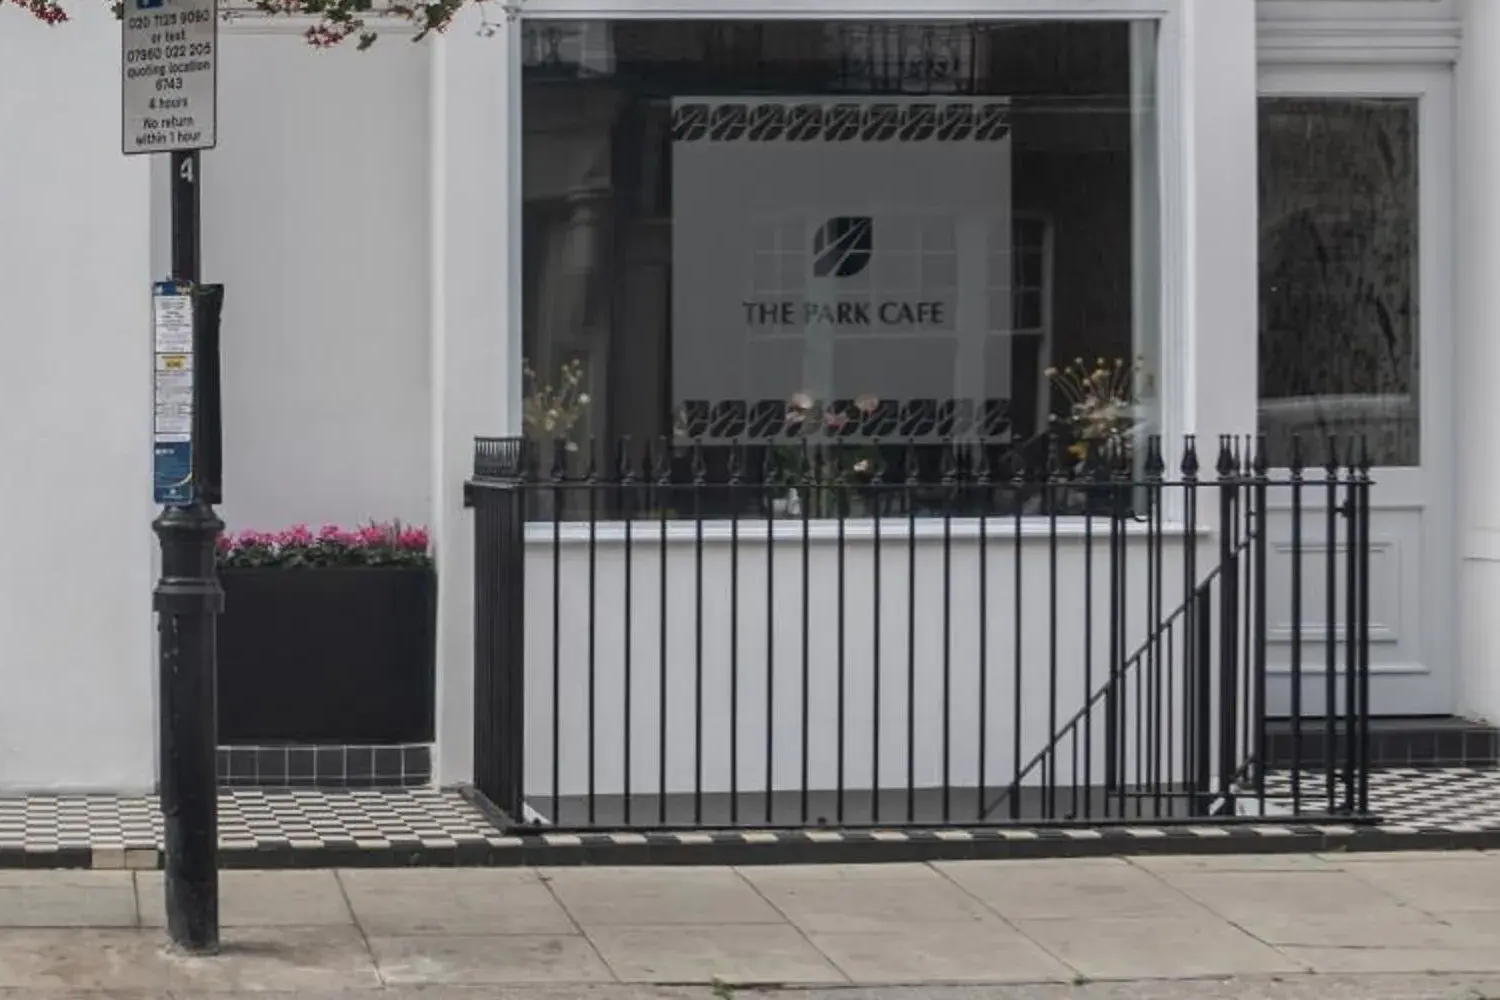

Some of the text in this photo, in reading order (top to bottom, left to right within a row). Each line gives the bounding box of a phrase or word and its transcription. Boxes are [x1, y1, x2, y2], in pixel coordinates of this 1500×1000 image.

[128, 15, 151, 30] 020
[151, 30, 186, 44] or text
[165, 44, 186, 59] 022
[127, 60, 211, 80] quoting location
[155, 76, 183, 92] 6743
[148, 95, 188, 109] 4 hours
[143, 114, 194, 130] No return
[135, 130, 202, 146] within 1 hour
[179, 156, 194, 183] 4
[743, 301, 945, 325] THE PARK CAFE
